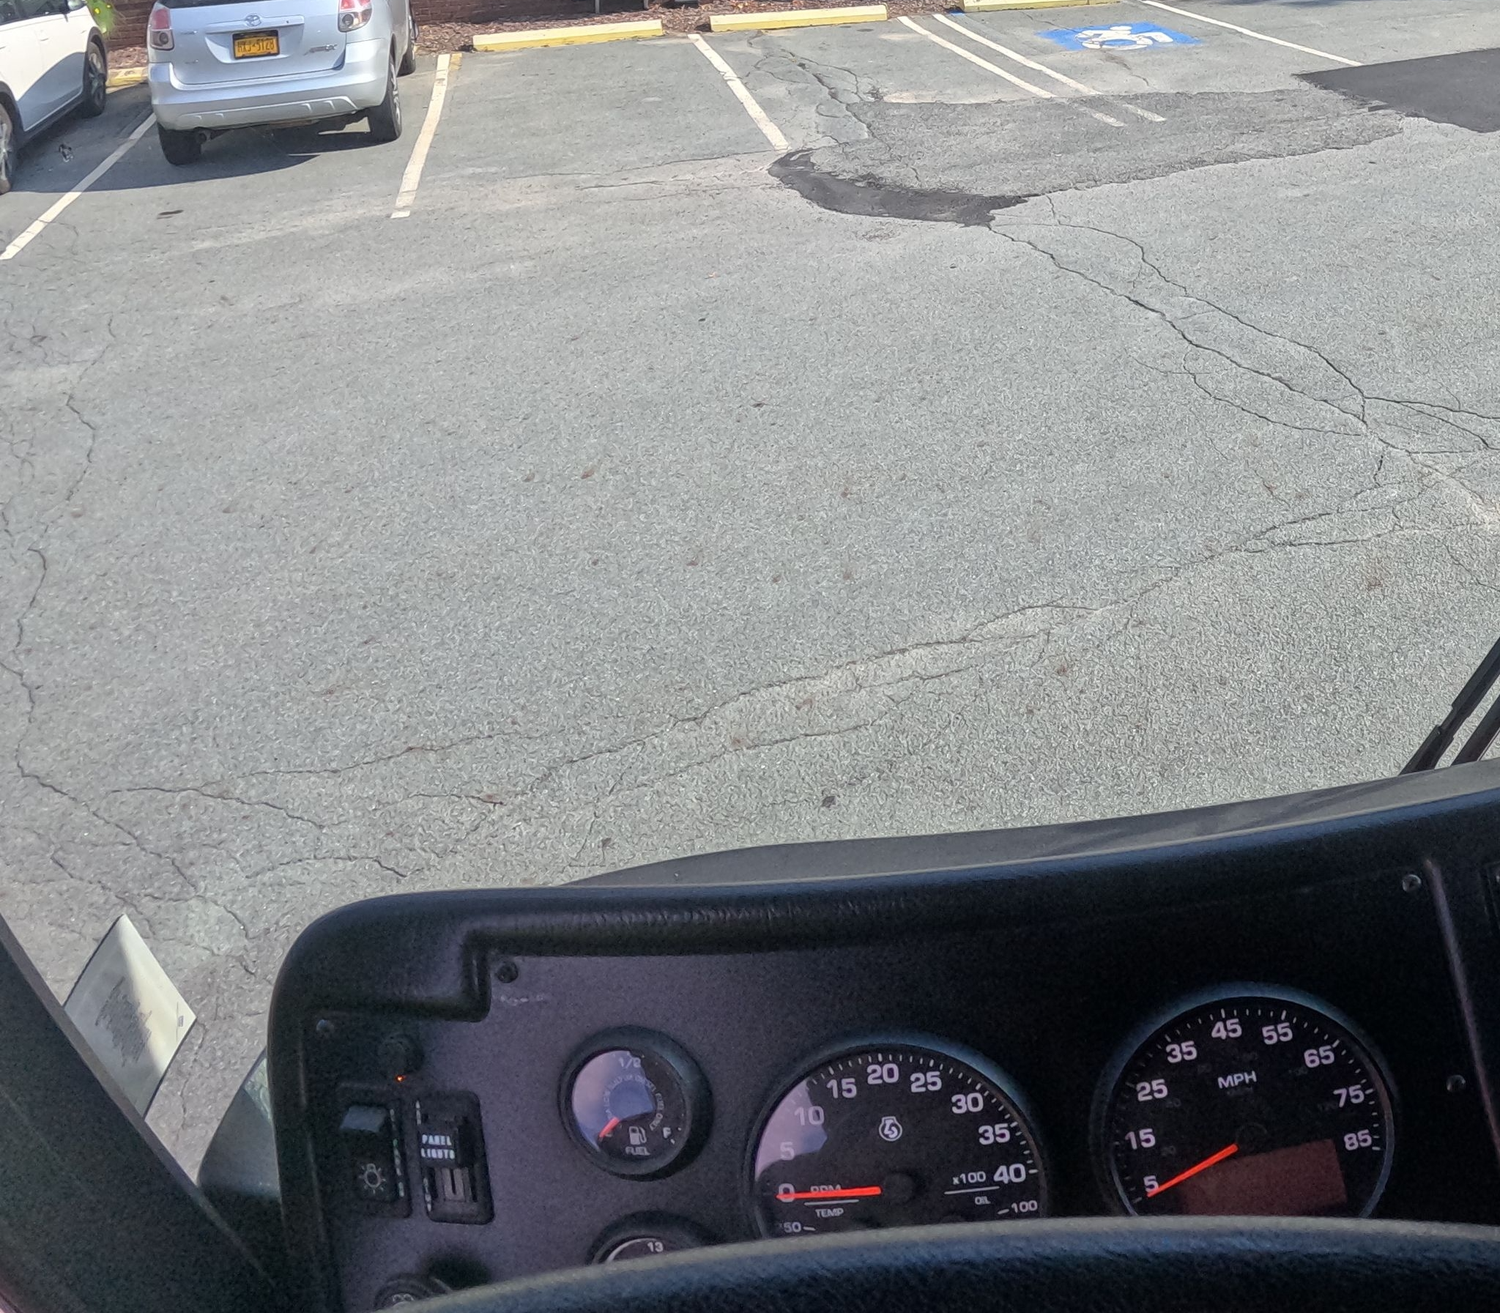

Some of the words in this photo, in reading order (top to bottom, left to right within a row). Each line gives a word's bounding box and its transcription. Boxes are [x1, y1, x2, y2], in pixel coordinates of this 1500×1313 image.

[1211, 1018, 1242, 1040] 45
[1261, 1022, 1293, 1045] 55
[1165, 1040, 1197, 1063] 35
[1303, 1045, 1335, 1069] 65
[619, 1057, 641, 1069] 1/2
[866, 1063, 899, 1084] 20
[910, 1071, 942, 1093] 25
[1217, 1070, 1257, 1089] MPH
[826, 1078, 857, 1099] 15
[1136, 1078, 1168, 1102] 25
[1333, 1085, 1365, 1108] 75
[951, 1092, 984, 1114] 30
[794, 1106, 824, 1126] 10
[421, 1134, 452, 1146] PANEL
[663, 1127, 672, 1138] F
[978, 1123, 1011, 1145] 35
[1124, 1128, 1156, 1150] 15
[1343, 1129, 1372, 1151] 85
[421, 1147, 455, 1159] LIGHTS
[625, 1146, 650, 1156] FUEL
[780, 1141, 796, 1160] 5
[953, 1171, 986, 1185] x100
[993, 1163, 1027, 1184] 40
[778, 1182, 796, 1202] 0
[1143, 1175, 1159, 1194] 5
[975, 1196, 991, 1206] OIL
[1011, 1200, 1039, 1213] 100
[815, 1207, 844, 1218] TEMP
[647, 1241, 664, 1253] 13
